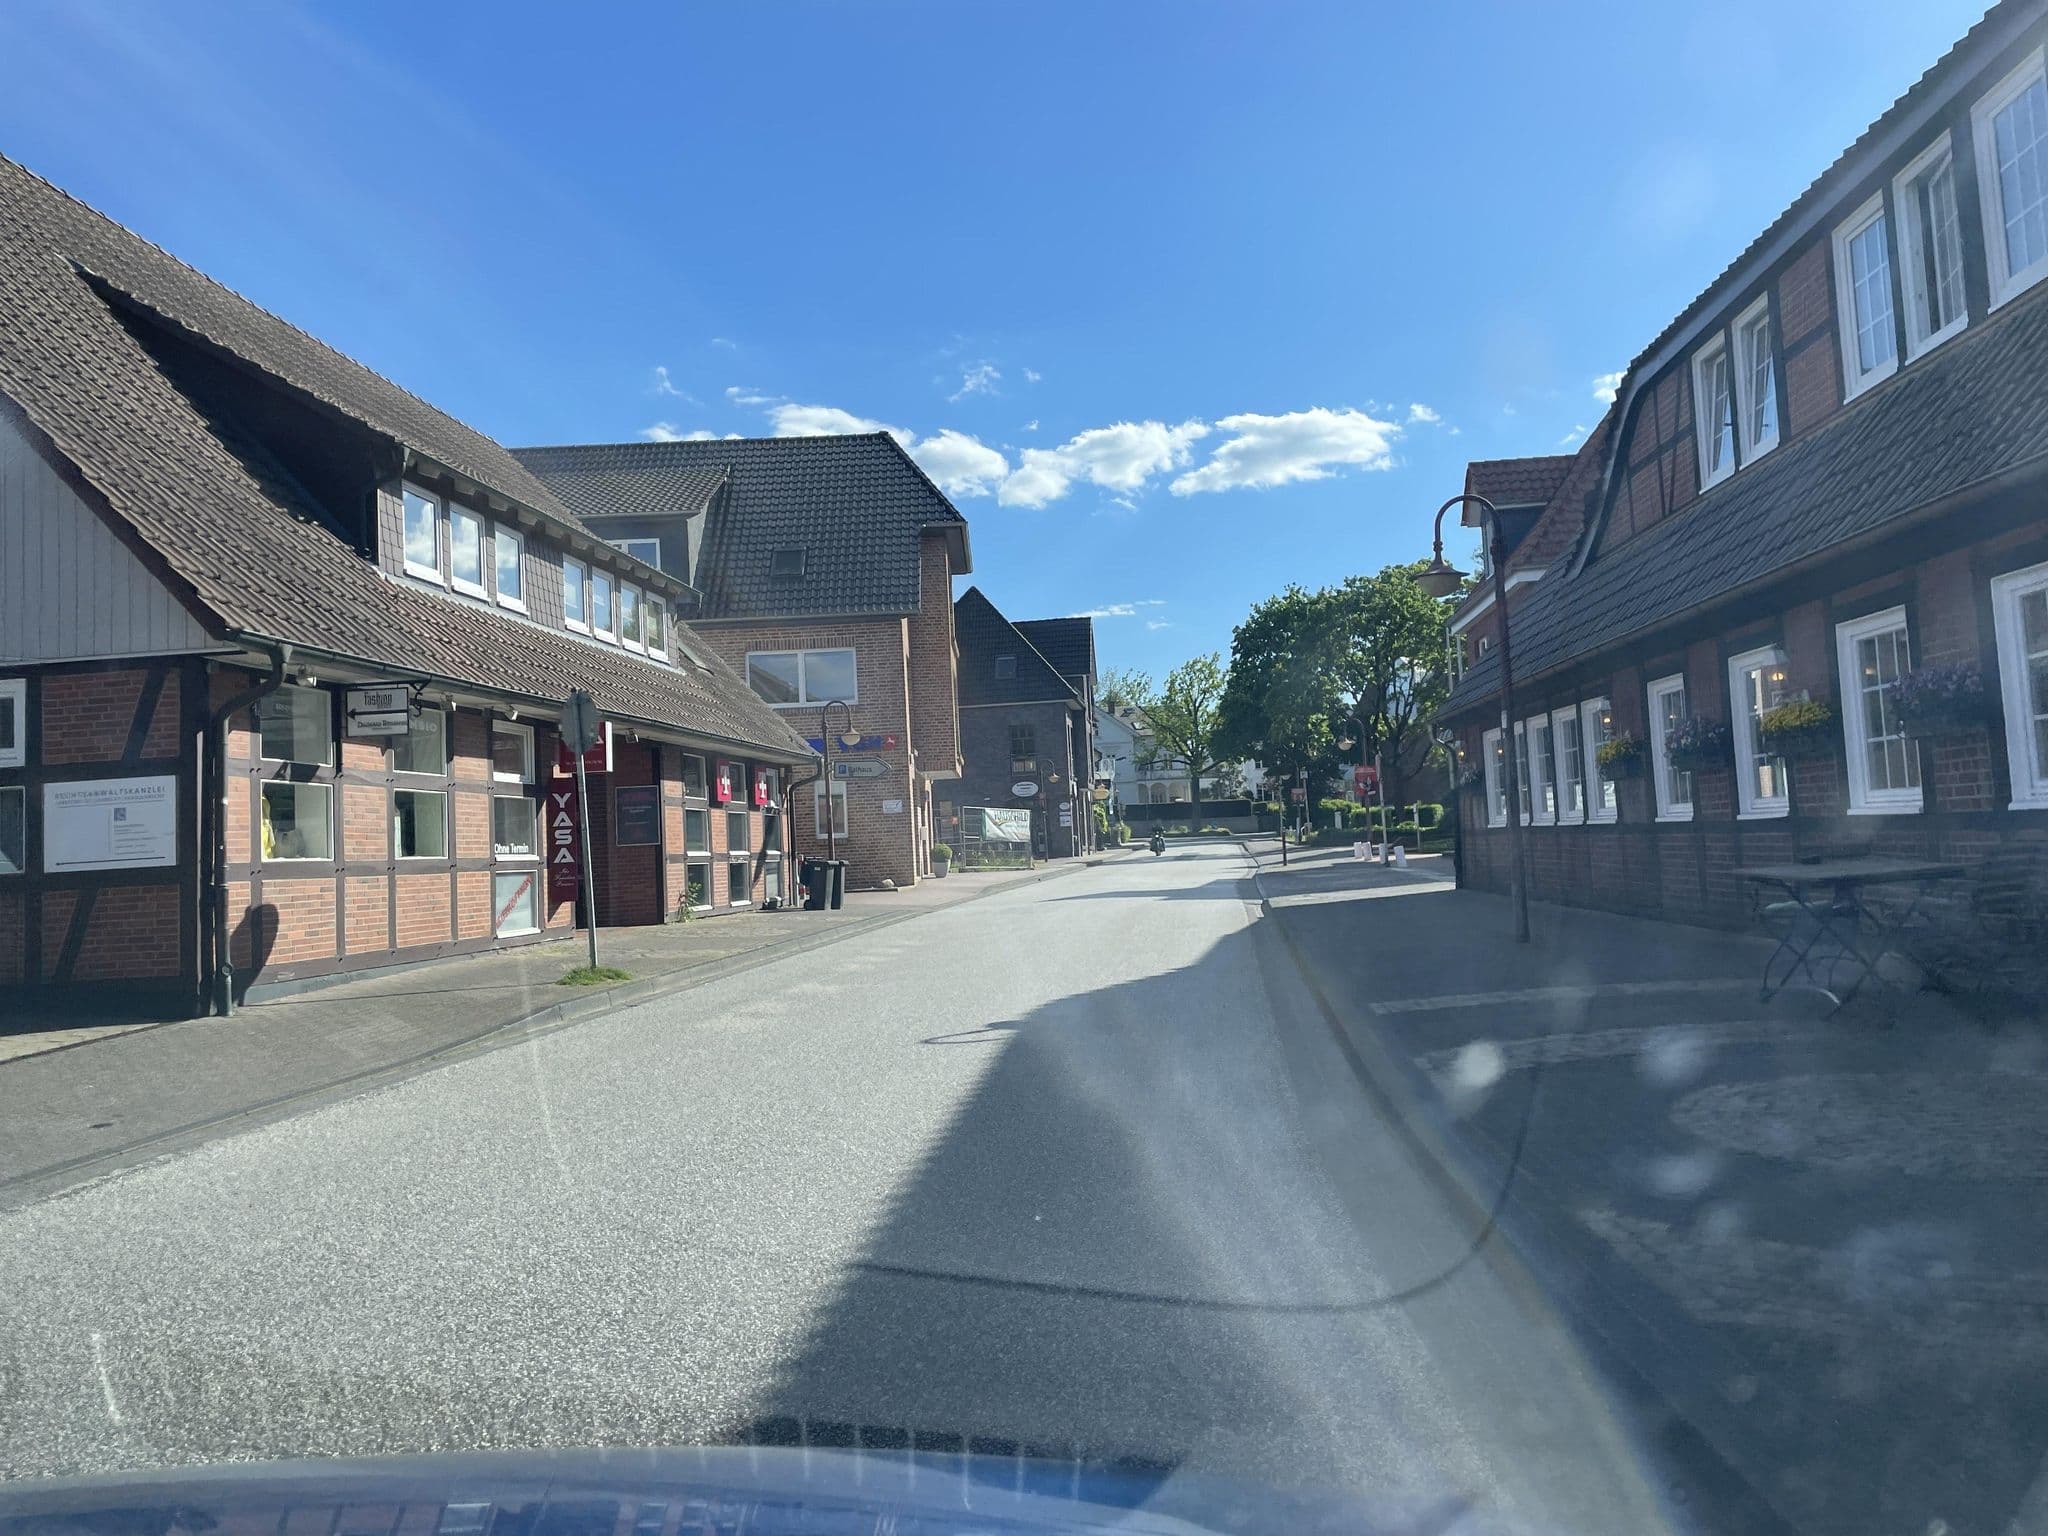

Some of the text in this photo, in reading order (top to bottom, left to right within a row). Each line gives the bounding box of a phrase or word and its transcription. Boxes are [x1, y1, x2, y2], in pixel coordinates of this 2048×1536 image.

[494, 842, 529, 853] Ohne Termin
[552, 792, 575, 864] YASA
